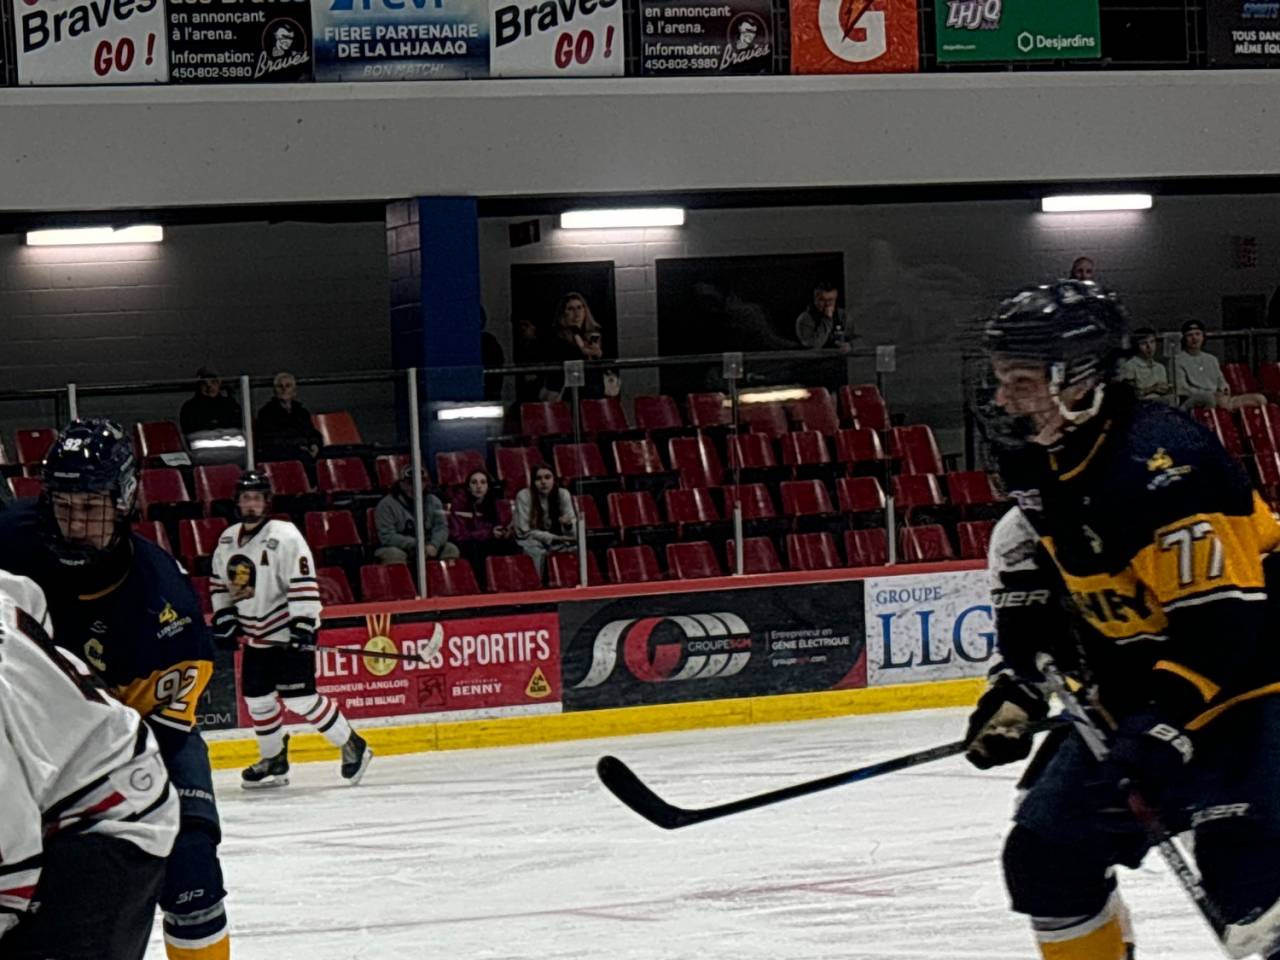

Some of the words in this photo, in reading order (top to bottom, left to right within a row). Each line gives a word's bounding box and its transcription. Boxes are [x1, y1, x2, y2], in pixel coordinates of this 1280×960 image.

[171, 13, 188, 24] en
[192, 10, 267, 25] annonçant
[645, 8, 661, 18] en
[664, 5, 731, 19] annonçant
[172, 28, 181, 41] à
[185, 28, 237, 42] l'arena.
[376, 23, 479, 40] PARTENAIRE
[646, 22, 655, 33] à
[658, 21, 705, 34] l'arena.
[1037, 34, 1095, 50] Desjardins
[1232, 30, 1257, 41] TOUS
[338, 43, 361, 58] DE
[364, 43, 387, 57] LA
[554, 29, 594, 69] GO
[645, 43, 721, 57] Information:
[94, 37, 135, 77] GO
[171, 51, 255, 65] Information:
[645, 57, 718, 70] 450-802-5980
[171, 66, 252, 79] 450-802-5980
[63, 438, 82, 451] 92
[876, 586, 944, 605] GROUPE
[448, 630, 550, 667] SPORTIFS
[155, 667, 200, 713] 92
[452, 682, 502, 697] BENNY
